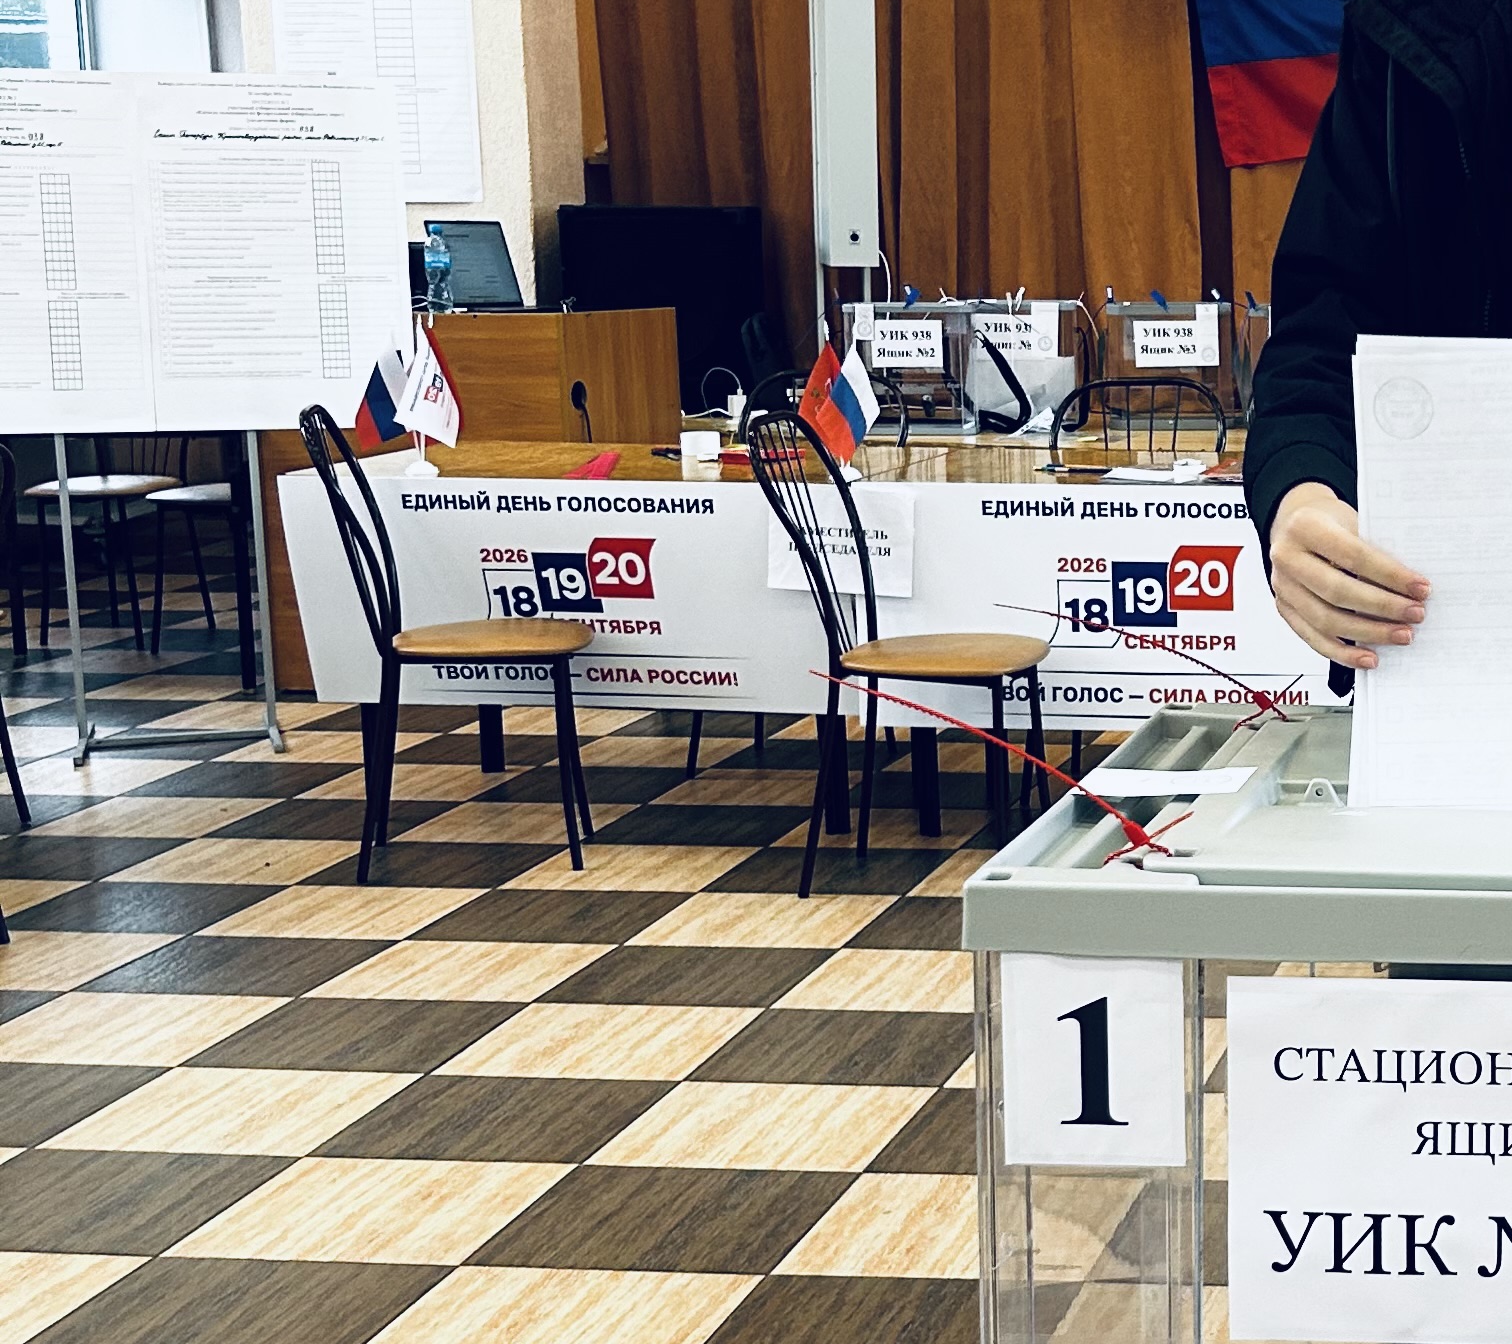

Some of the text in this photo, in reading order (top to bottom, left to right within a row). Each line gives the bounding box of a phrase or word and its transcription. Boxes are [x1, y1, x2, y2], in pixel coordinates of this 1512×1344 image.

[880, 330, 932, 341] УИК 938
[984, 323, 1011, 332] УИК
[1143, 328, 1193, 337] УИК 938
[877, 347, 935, 358] Ящик №2
[1141, 345, 1174, 354] Ящик
[401, 491, 714, 514] ЕДИНЫЙ ДЕНЬ ГОЛОСОВАНИЯ
[982, 497, 1250, 520] ЕДИНЫЙ ДЕНЬ ГОЛОСОВ
[480, 548, 528, 563] 2026
[1057, 558, 1107, 572] 2026
[493, 552, 645, 618] 18 19 20
[1064, 560, 1229, 633] 18 19 20
[563, 618, 662, 635] НТЯБРЯ
[1124, 635, 1236, 650] СЕНТЯБРЯ
[494, 665, 557, 682] ГОЛО
[587, 667, 643, 683] СИЛА
[649, 669, 738, 686] РОССИИ!
[1052, 686, 1123, 703] ГОЛОС
[1149, 688, 1207, 703] СИЛА
[1057, 997, 1129, 1126] 1
[1263, 1209, 1458, 1276] УИК
